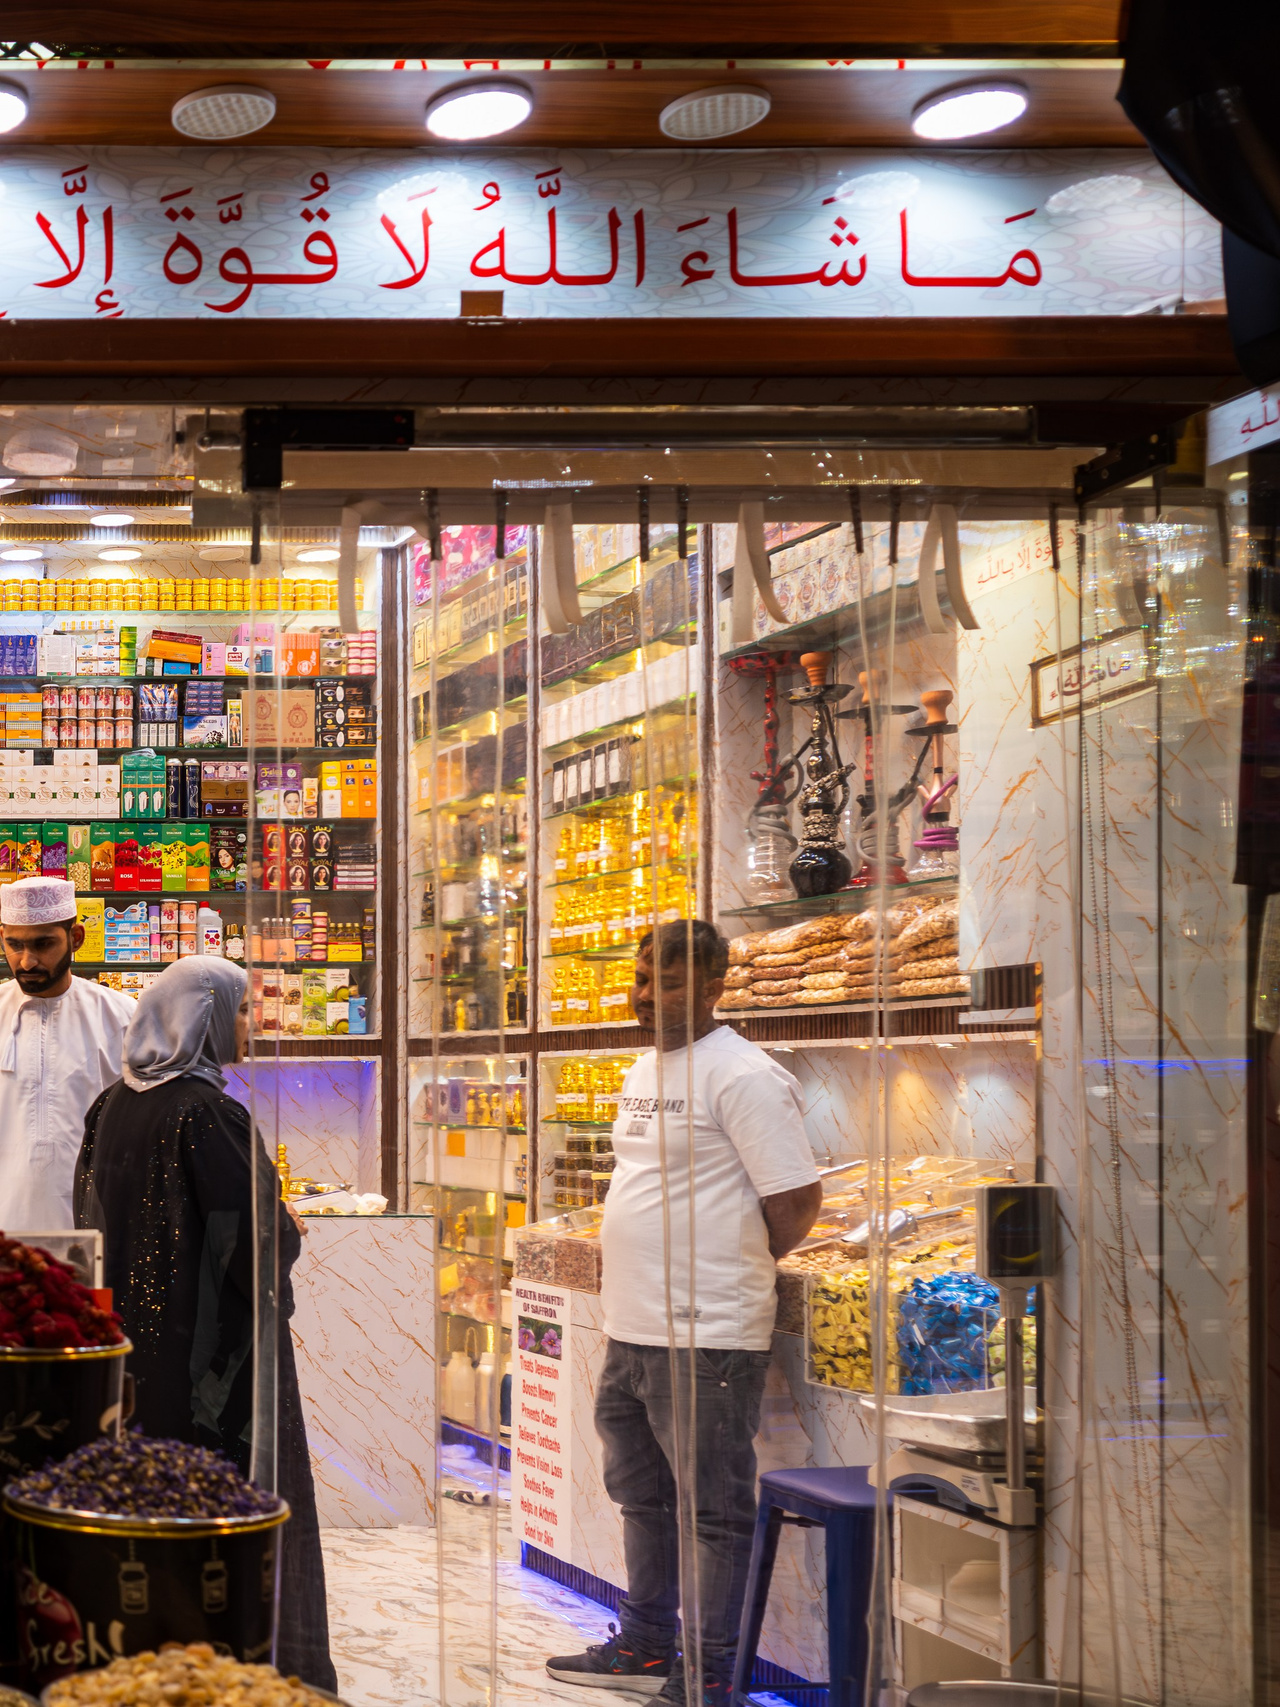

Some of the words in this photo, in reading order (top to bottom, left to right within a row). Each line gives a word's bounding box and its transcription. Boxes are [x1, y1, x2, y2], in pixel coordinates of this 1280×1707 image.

[651, 1098, 685, 1113] BAND
[516, 1288, 537, 1301] HEALTH
[538, 1293, 564, 1306] BENEFITS
[523, 1302, 529, 1312] OF
[531, 1304, 557, 1318] SAFFRON
[520, 1355, 534, 1373] Treats
[535, 1359, 559, 1380] Depression
[522, 1379, 537, 1397] Boosts
[538, 1383, 556, 1407] Memory
[521, 1403, 540, 1422] Prevents
[541, 1409, 558, 1428] Cancer
[518, 1425, 536, 1445] Relieves
[537, 1431, 561, 1454] Toothache
[517, 1447, 536, 1468] Prevents
[536, 1455, 549, 1474] Vision
[551, 1460, 562, 1479] Loss
[523, 1474, 541, 1494] Soothes
[542, 1480, 555, 1499] Fever
[521, 1496, 533, 1517] Helps
[534, 1502, 538, 1513] in
[539, 1504, 558, 1526] Arthritis
[524, 1521, 536, 1540] Good
[544, 1529, 554, 1548] Skin
[27, 1617, 126, 1670] fresh!
